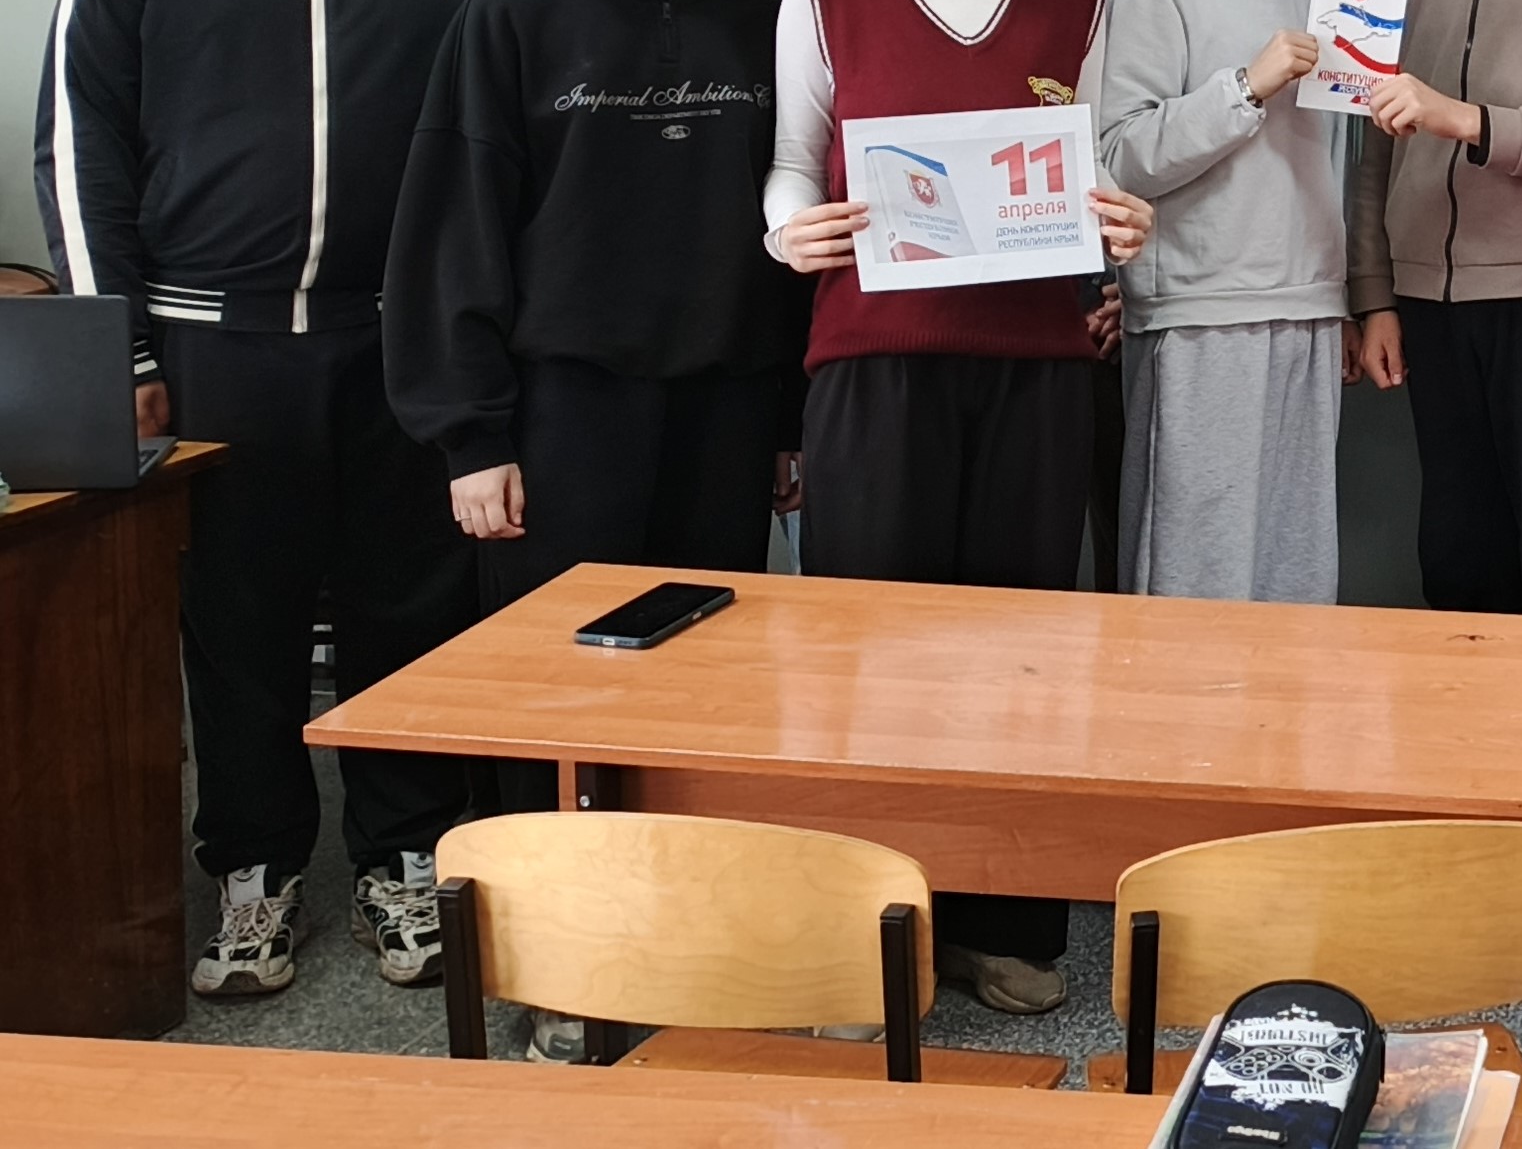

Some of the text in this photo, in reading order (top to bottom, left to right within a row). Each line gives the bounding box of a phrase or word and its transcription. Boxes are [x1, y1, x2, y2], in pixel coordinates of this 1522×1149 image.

[554, 82, 654, 113] Imperial
[653, 80, 753, 106] Ambition
[991, 138, 1064, 196] 11
[998, 200, 1067, 221] апреля
[996, 221, 1079, 237] ДЕНЬ КОНСТИТУЦИИ
[998, 234, 1079, 249] РЕСПУБЛИКИ КРЫМ
